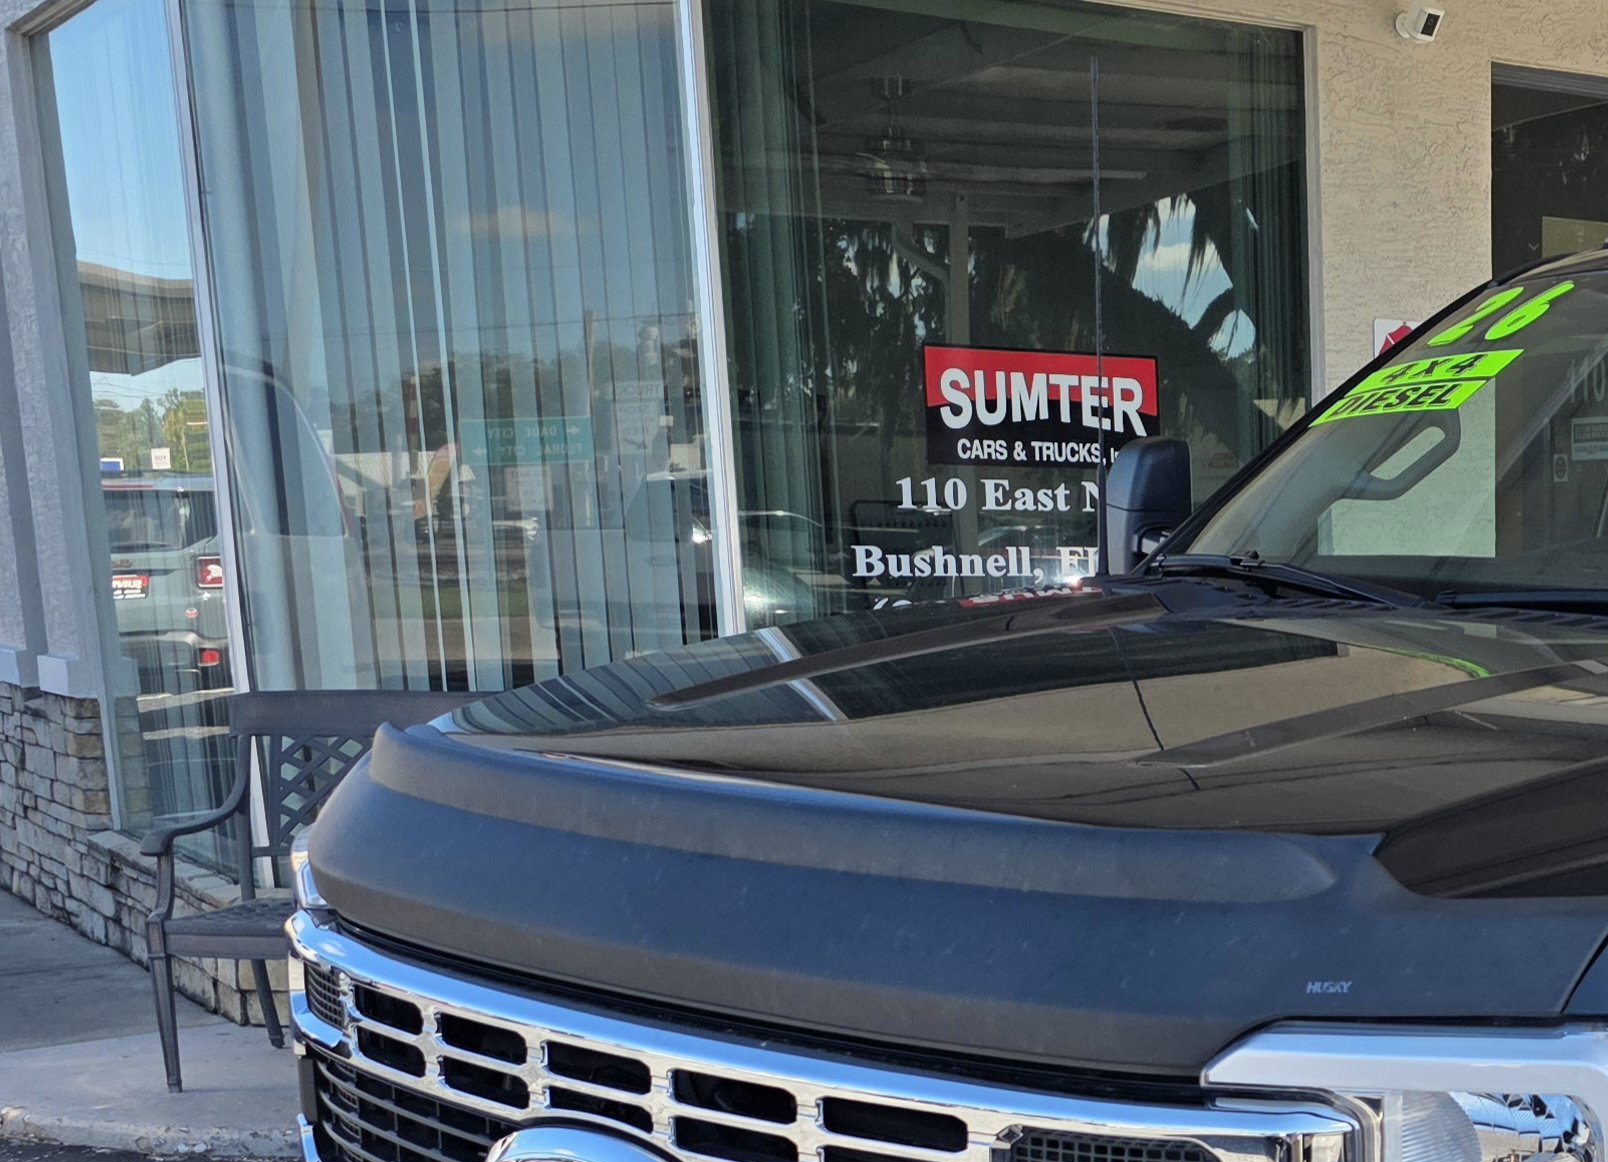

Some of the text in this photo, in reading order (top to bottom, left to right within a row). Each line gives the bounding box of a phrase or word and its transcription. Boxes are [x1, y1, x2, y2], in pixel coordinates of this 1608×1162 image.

[1426, 279, 1576, 348] 26
[939, 366, 1148, 438] SUMTER
[1332, 383, 1465, 418] DIESEL
[957, 439, 1008, 462] CARS
[1013, 442, 1027, 462] &
[896, 477, 967, 512] 110
[981, 479, 1071, 512] East
[850, 545, 1045, 583] Bushnell,
